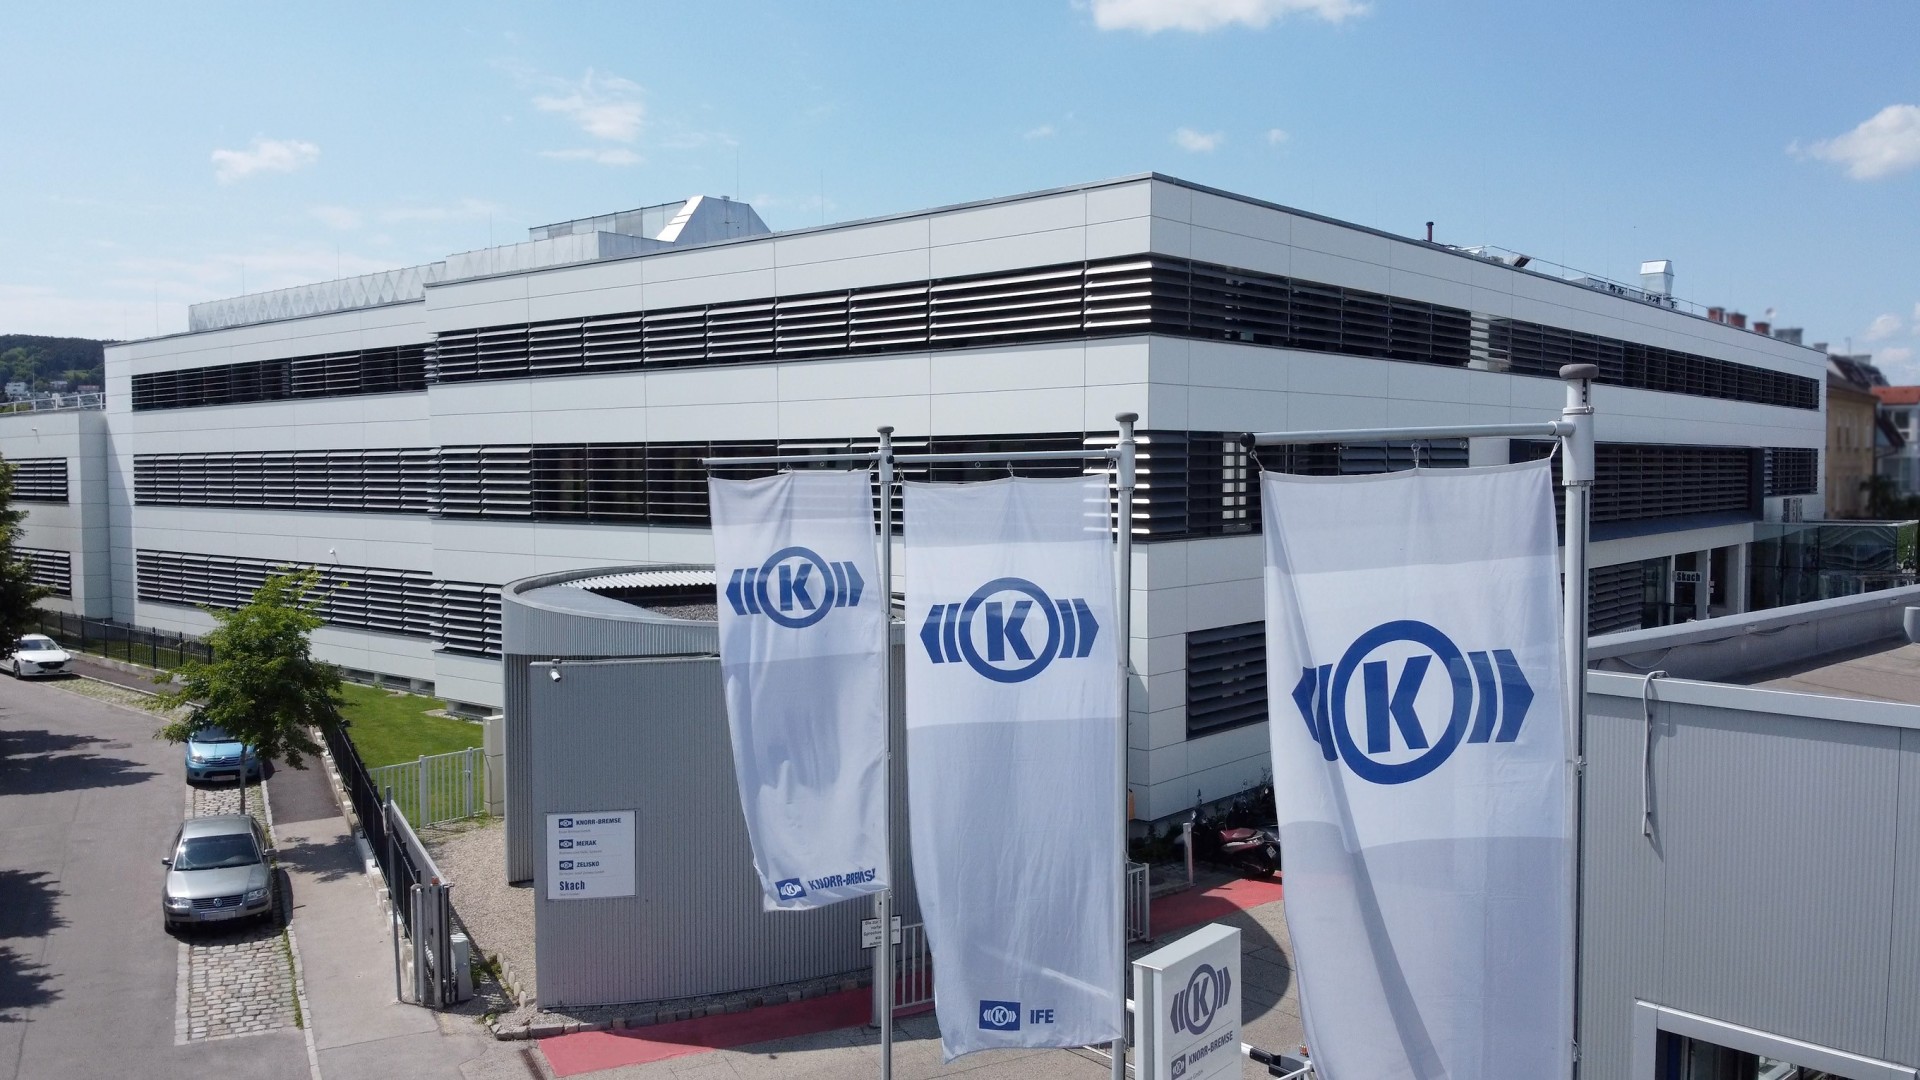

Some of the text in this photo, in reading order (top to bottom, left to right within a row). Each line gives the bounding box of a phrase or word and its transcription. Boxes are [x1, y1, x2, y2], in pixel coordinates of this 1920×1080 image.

[778, 563, 817, 612] K
[985, 600, 1036, 662] K
[1363, 654, 1432, 755] K
[575, 818, 622, 826] KNORR-BREMSE
[559, 880, 585, 891] Skach
[1030, 1009, 1054, 1025] IFE
[1193, 976, 1210, 1023] K
[1188, 1030, 1233, 1066] KNORR-BREMSE
